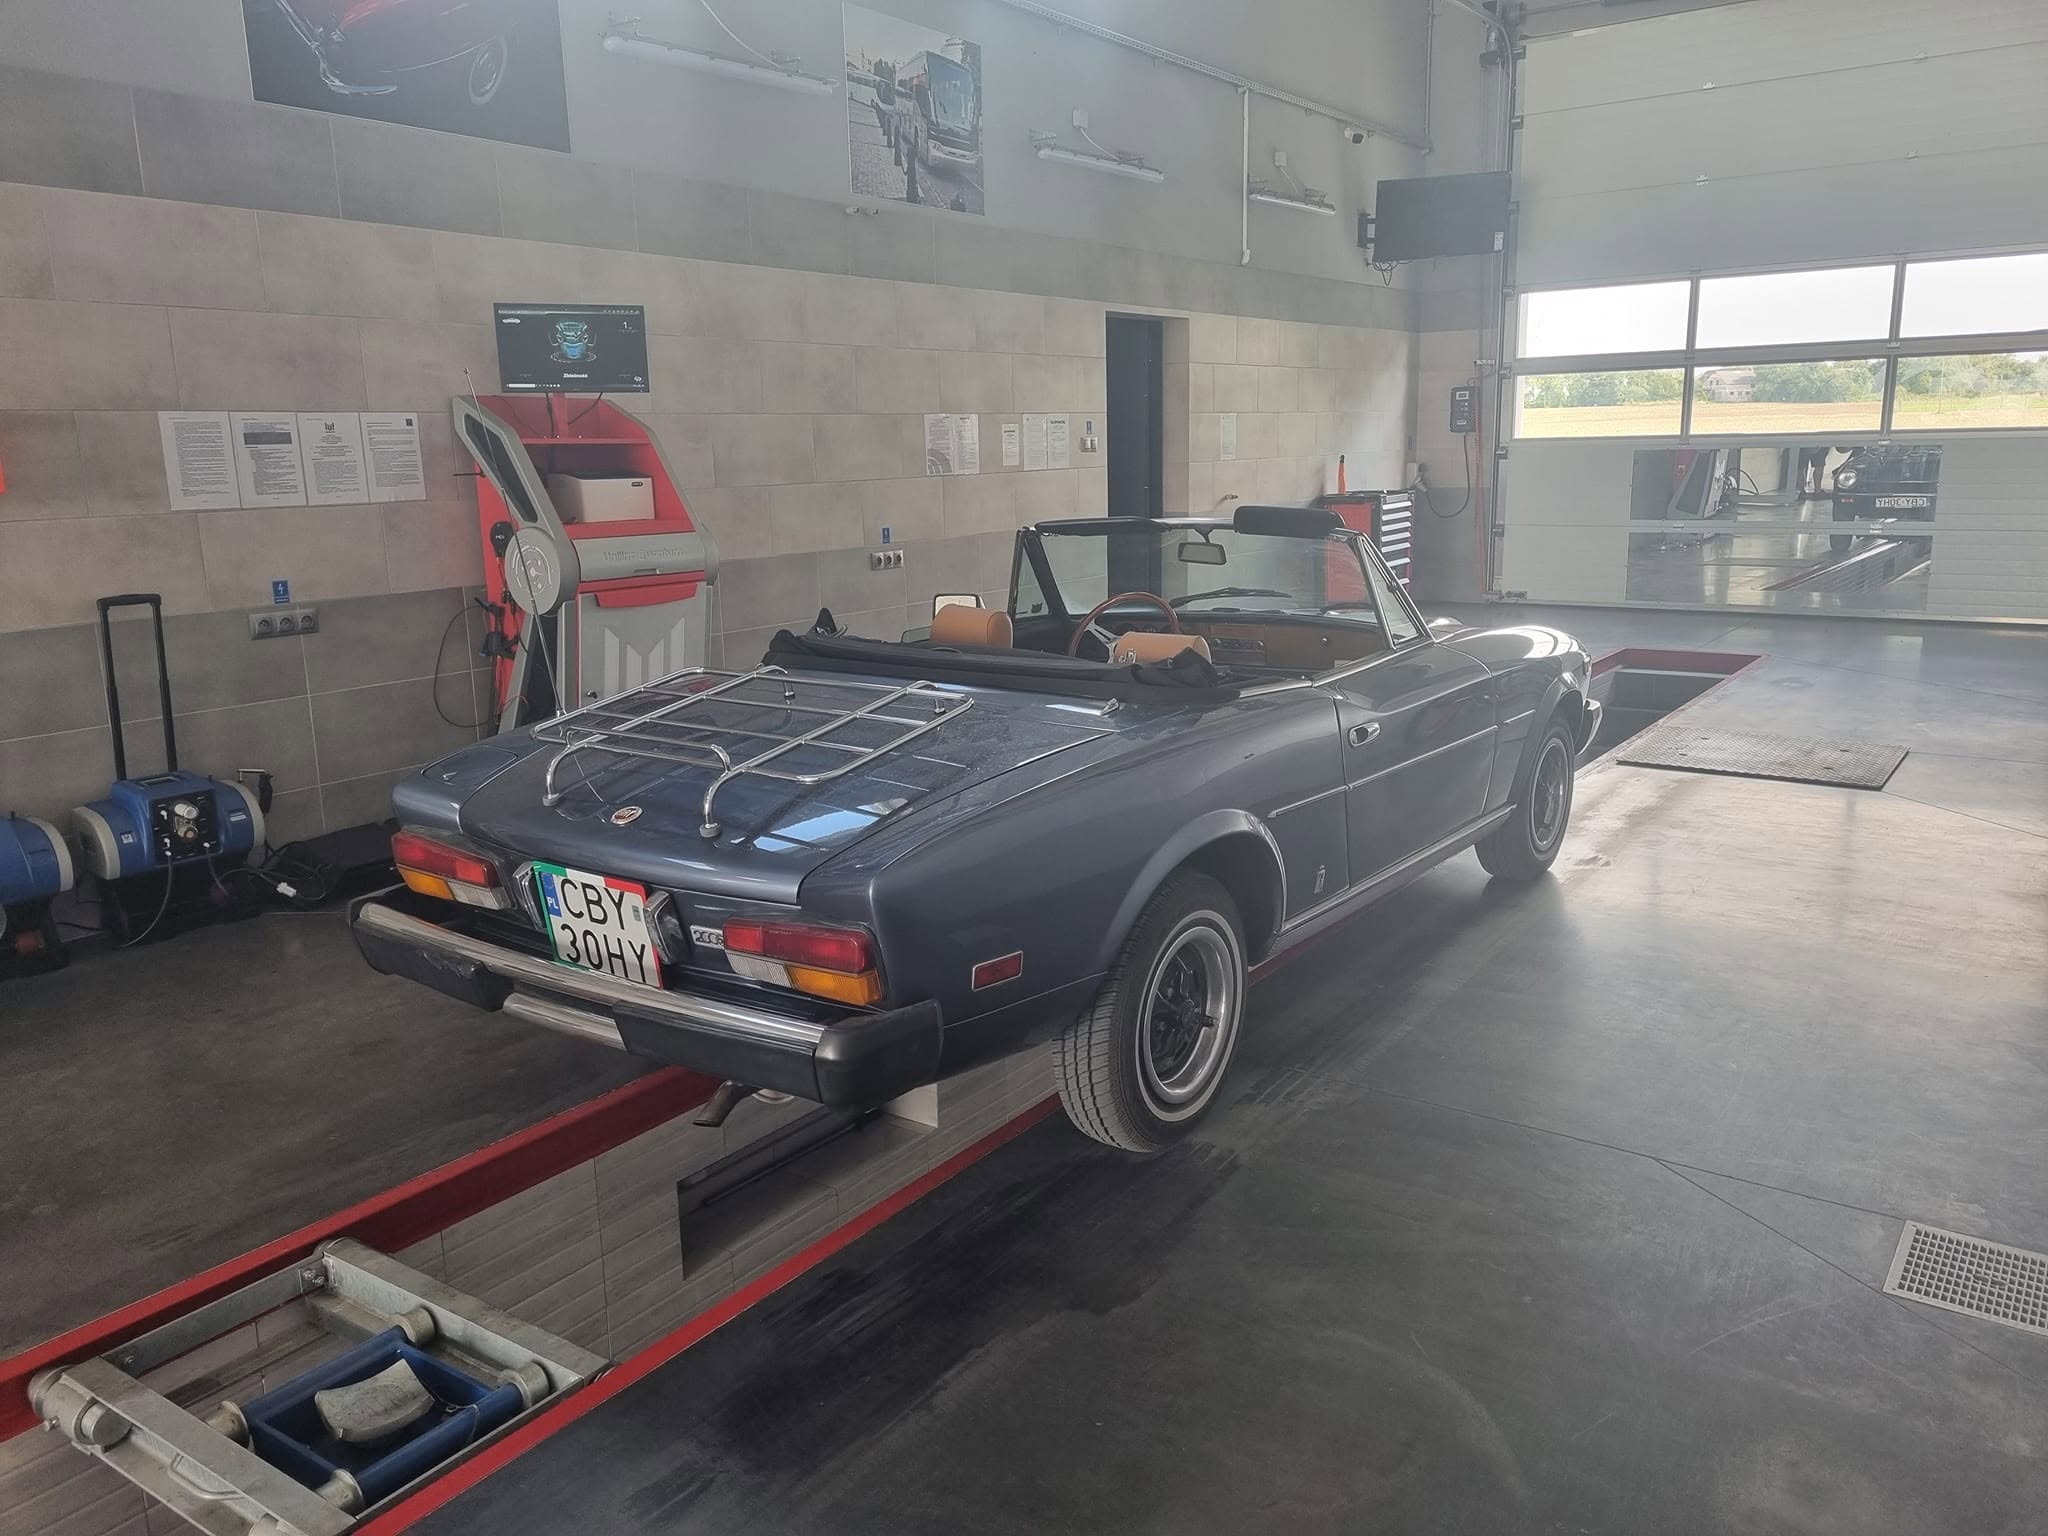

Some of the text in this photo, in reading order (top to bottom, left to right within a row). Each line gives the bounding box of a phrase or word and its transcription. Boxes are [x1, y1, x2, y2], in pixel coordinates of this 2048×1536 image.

[546, 895, 559, 910] PL
[560, 878, 625, 931] CBY
[560, 923, 647, 984] 30HY
